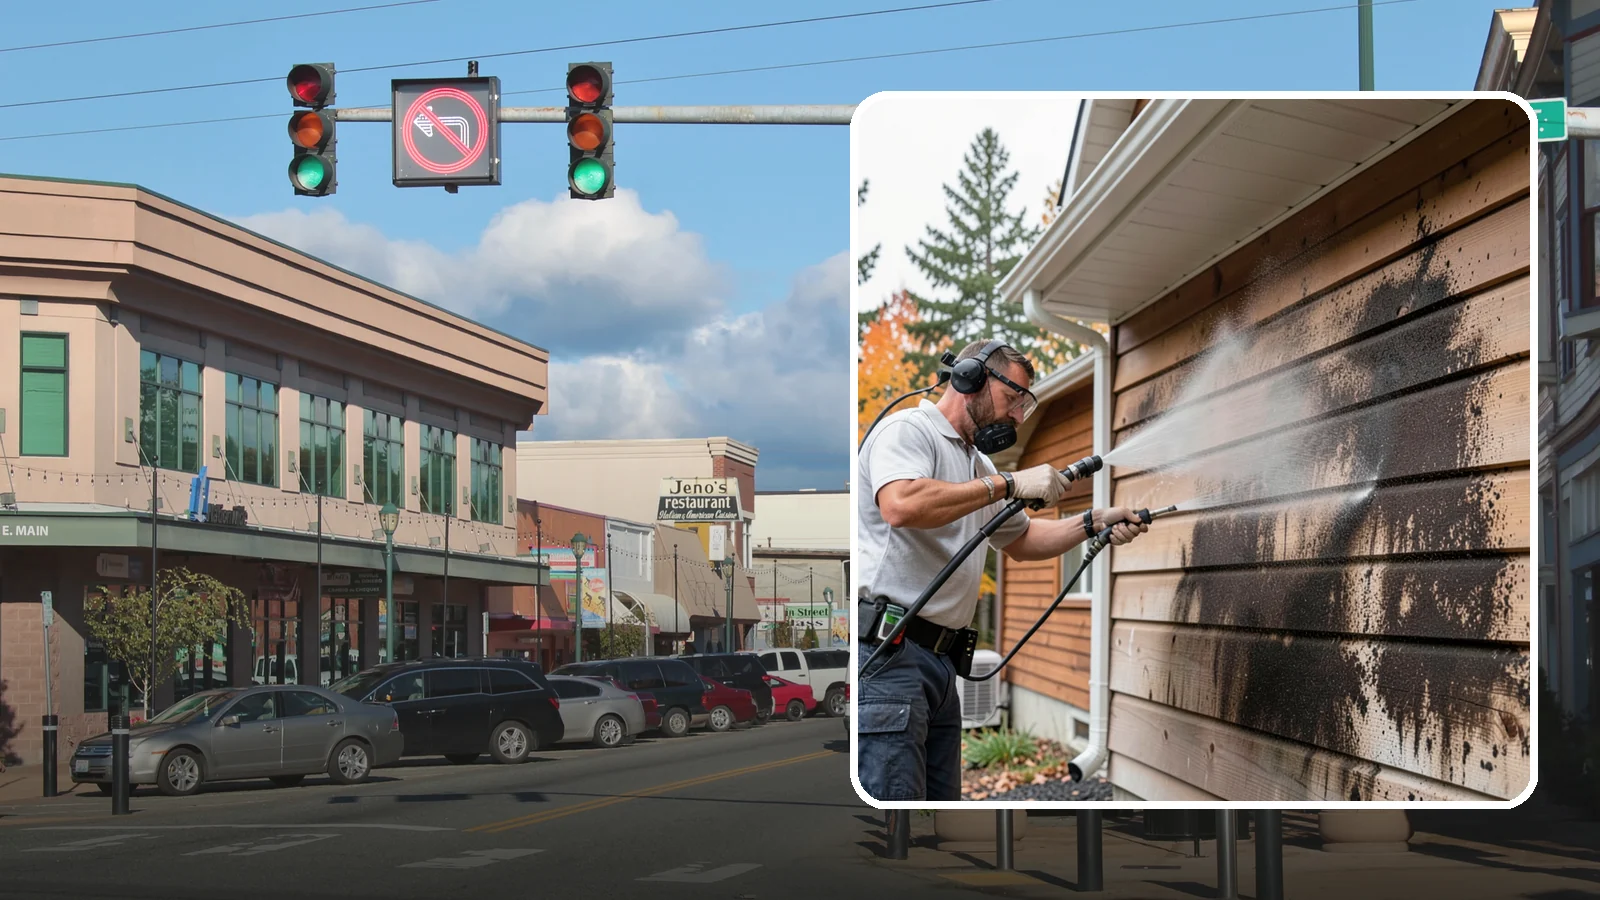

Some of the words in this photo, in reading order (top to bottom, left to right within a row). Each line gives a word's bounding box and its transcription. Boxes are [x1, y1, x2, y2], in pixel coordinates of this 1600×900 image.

[671, 481, 727, 494] Jeno's
[665, 496, 731, 509] restaurant
[659, 510, 681, 519] Italian
[686, 510, 714, 518] American
[715, 510, 737, 518] Cuisine
[2, 525, 13, 536] E.
[15, 525, 49, 536] MAIN
[786, 607, 795, 617] in
[797, 607, 829, 617] Street
